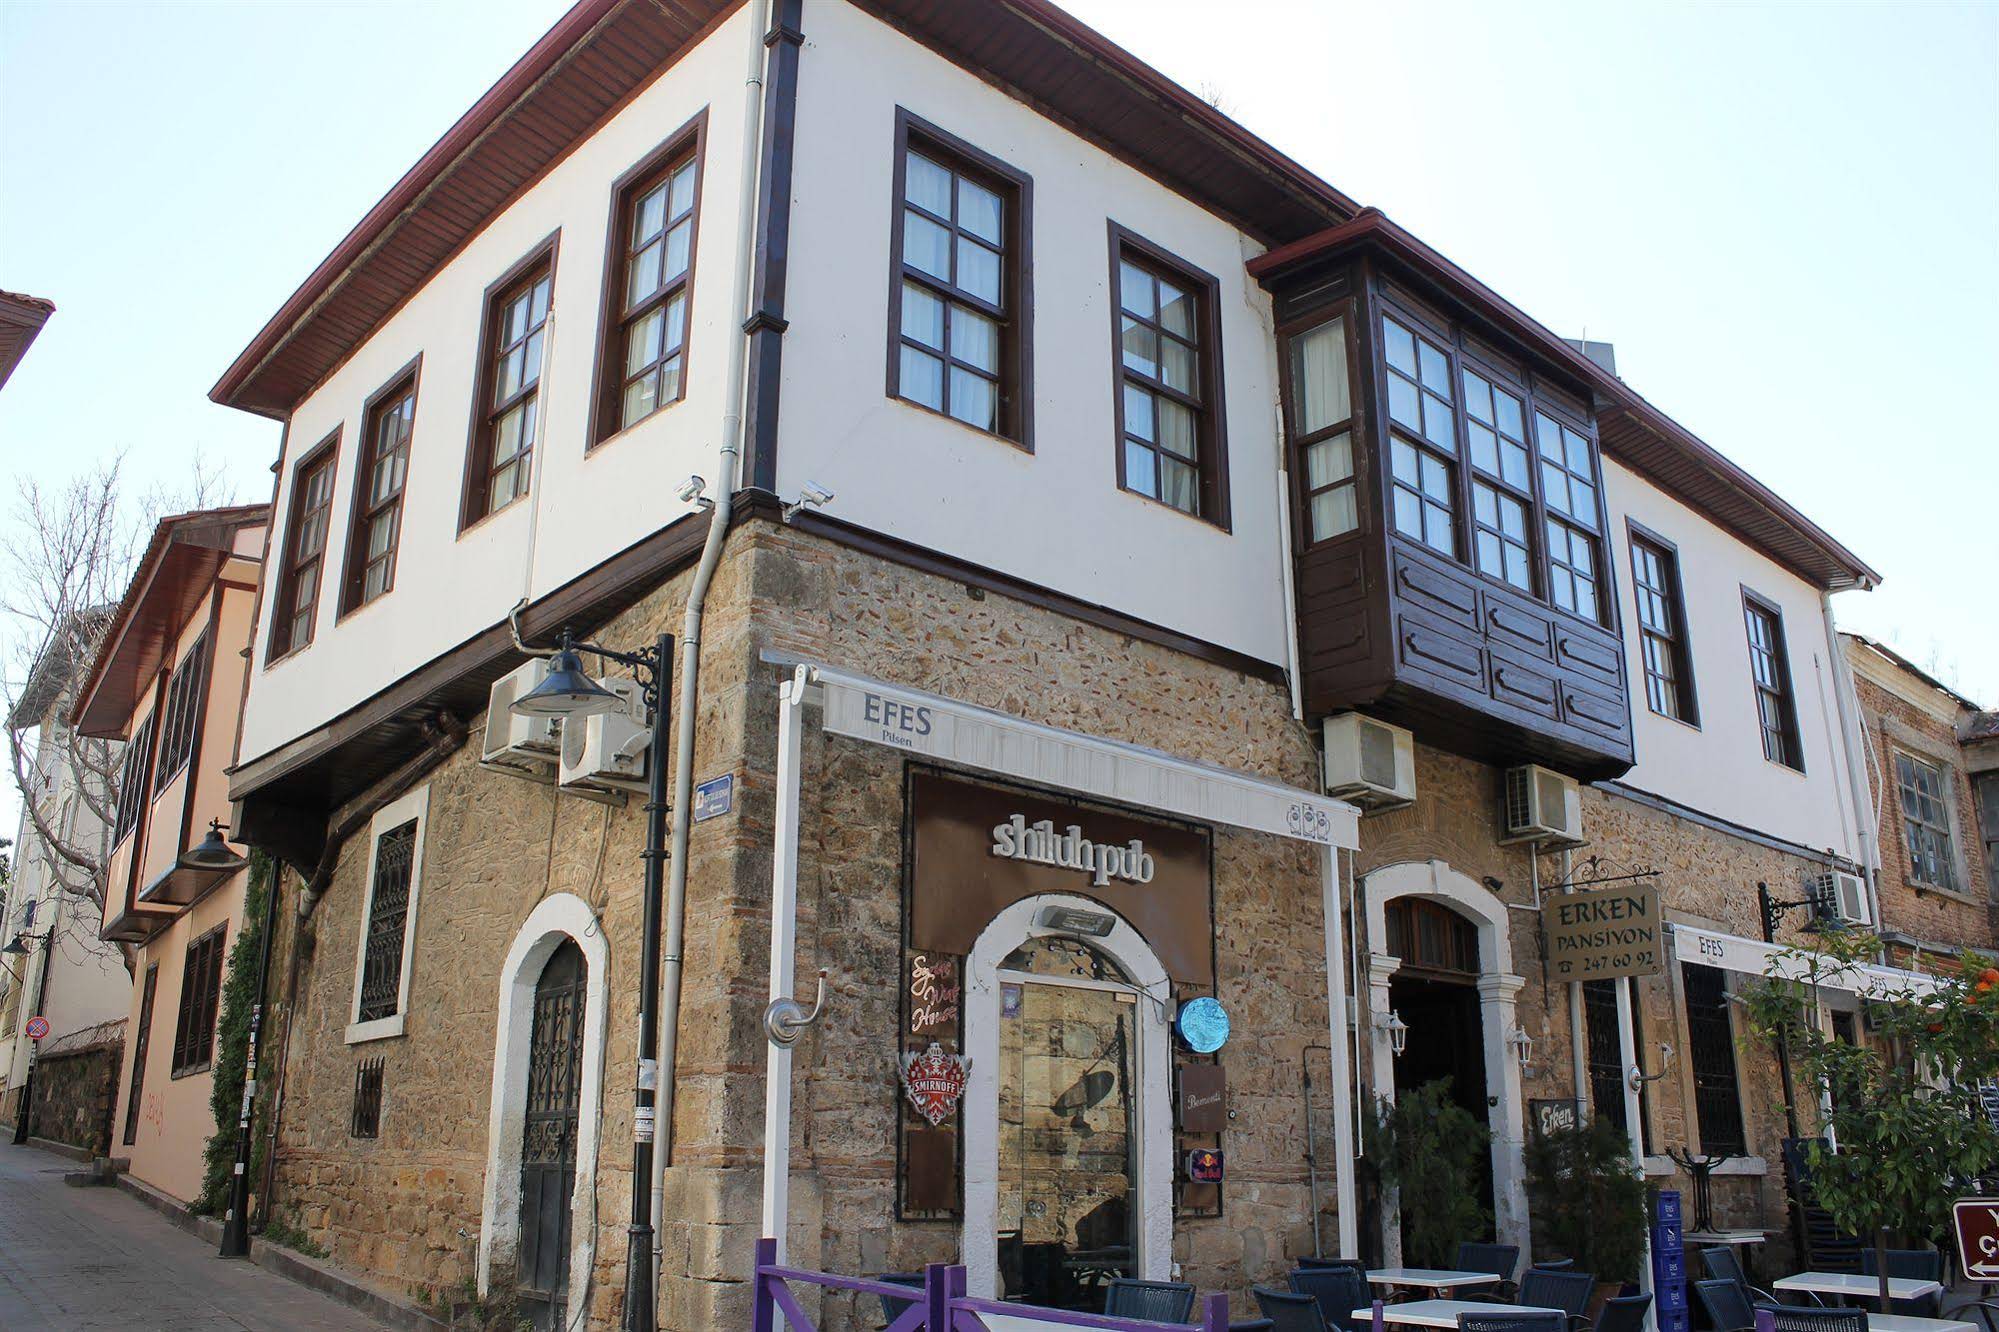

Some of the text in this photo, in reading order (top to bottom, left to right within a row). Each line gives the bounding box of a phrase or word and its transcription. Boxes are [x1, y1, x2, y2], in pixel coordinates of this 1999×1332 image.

[864, 687, 931, 735] EFES
[882, 730, 913, 747] Pilsen
[1558, 895, 1646, 926] ERKEN
[1556, 926, 1654, 952] PANSİYON
[1698, 936, 1724, 957] EFES
[1583, 950, 1654, 971] 247 60 92
[914, 1080, 956, 1094] SMIRNOFF
